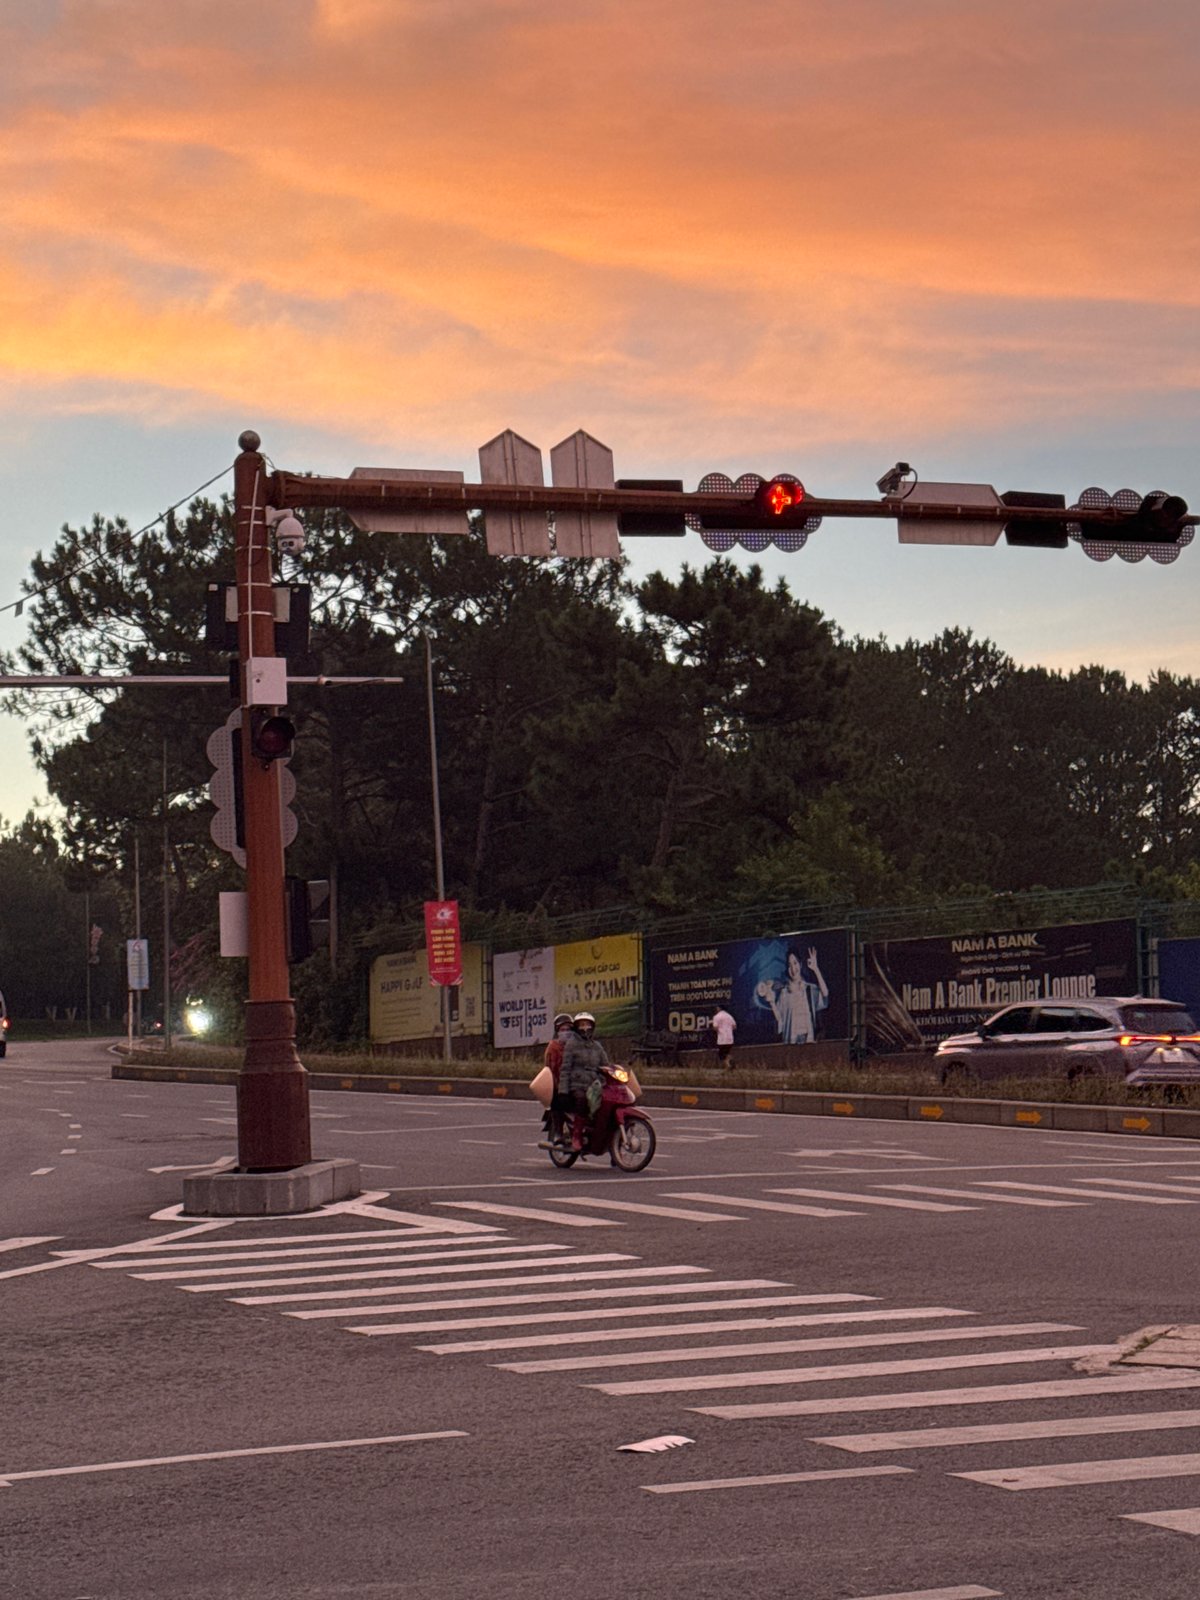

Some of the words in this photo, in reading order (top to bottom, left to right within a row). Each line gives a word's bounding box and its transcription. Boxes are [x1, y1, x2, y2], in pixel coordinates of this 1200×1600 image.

[951, 938, 984, 953] NAM
[986, 937, 996, 950] A
[998, 933, 1038, 948] BANK
[667, 952, 687, 964] NAM
[688, 951, 694, 961] A
[695, 949, 719, 960] BANK
[380, 979, 403, 994] HAPPY
[584, 975, 638, 1001] SUMMIT
[668, 981, 690, 991] THANH
[690, 978, 707, 989] TOÁN
[707, 978, 721, 988] HỌC
[902, 983, 931, 1011] Nam
[934, 981, 945, 1009] A
[948, 979, 983, 1008] Bank
[985, 974, 1040, 1006] Premier
[1044, 972, 1096, 999] Lounge
[686, 991, 703, 1003] open
[703, 989, 731, 1000] banking
[498, 1000, 523, 1012] WORLD
[528, 1013, 547, 1027] 2025
